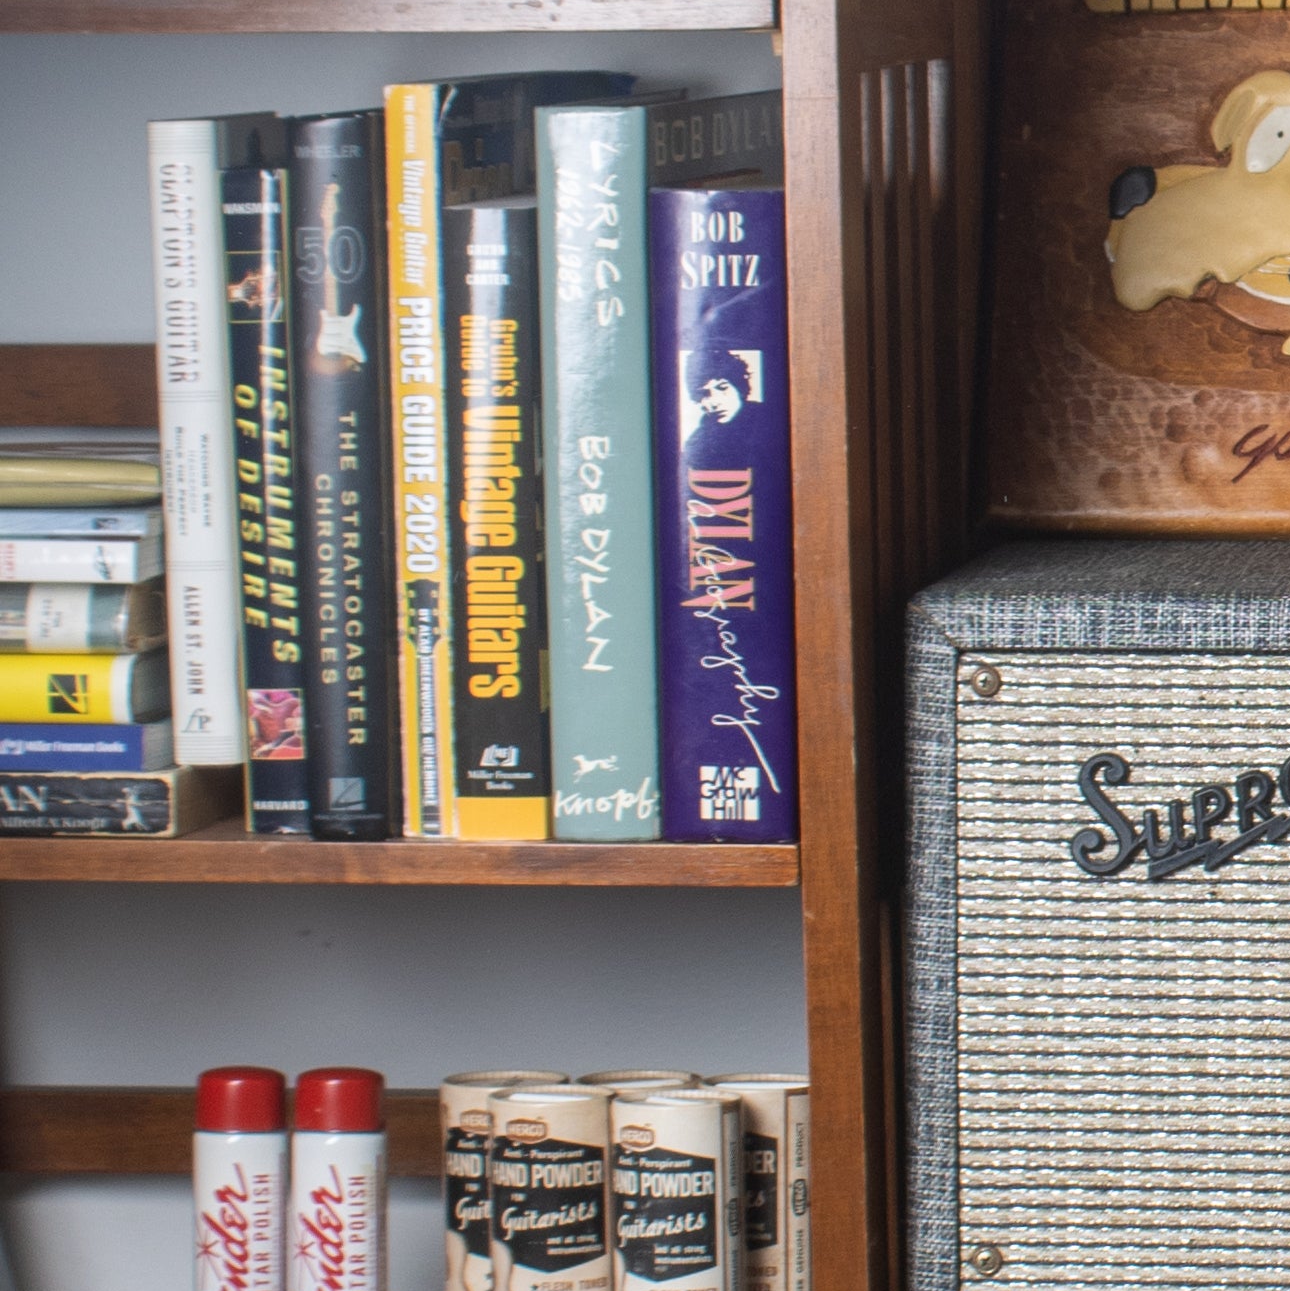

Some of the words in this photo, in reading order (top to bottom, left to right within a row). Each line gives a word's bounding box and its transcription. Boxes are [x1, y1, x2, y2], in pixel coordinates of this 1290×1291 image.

[398, 160, 425, 227] Vintage
[691, 211, 745, 243] BOB
[296, 225, 367, 284] 50
[403, 232, 427, 286] Guitar
[587, 141, 624, 327] LYRICS
[680, 251, 760, 290] SPITZ
[398, 297, 434, 385] PRICE
[235, 384, 260, 439] OF
[339, 411, 358, 471] THE
[402, 395, 437, 484] GUIDE
[259, 344, 301, 663] INSTRUMENTS
[460, 405, 522, 547] Vintage
[579, 435, 611, 516] BOB
[238, 458, 269, 629] DESIRE
[404, 494, 440, 573] 2020
[680, 468, 755, 611] DYLAN
[315, 474, 340, 684] CHRONICLES
[341, 490, 368, 745] STRATOCASTER
[574, 529, 614, 672] DYLAN
[466, 556, 527, 699] Guitars
[252, 800, 308, 811] HARVARD
[252, 1174, 270, 1241] POLISH
[531, 1160, 603, 1188] POWDER
[501, 1201, 597, 1241] Guitarists
